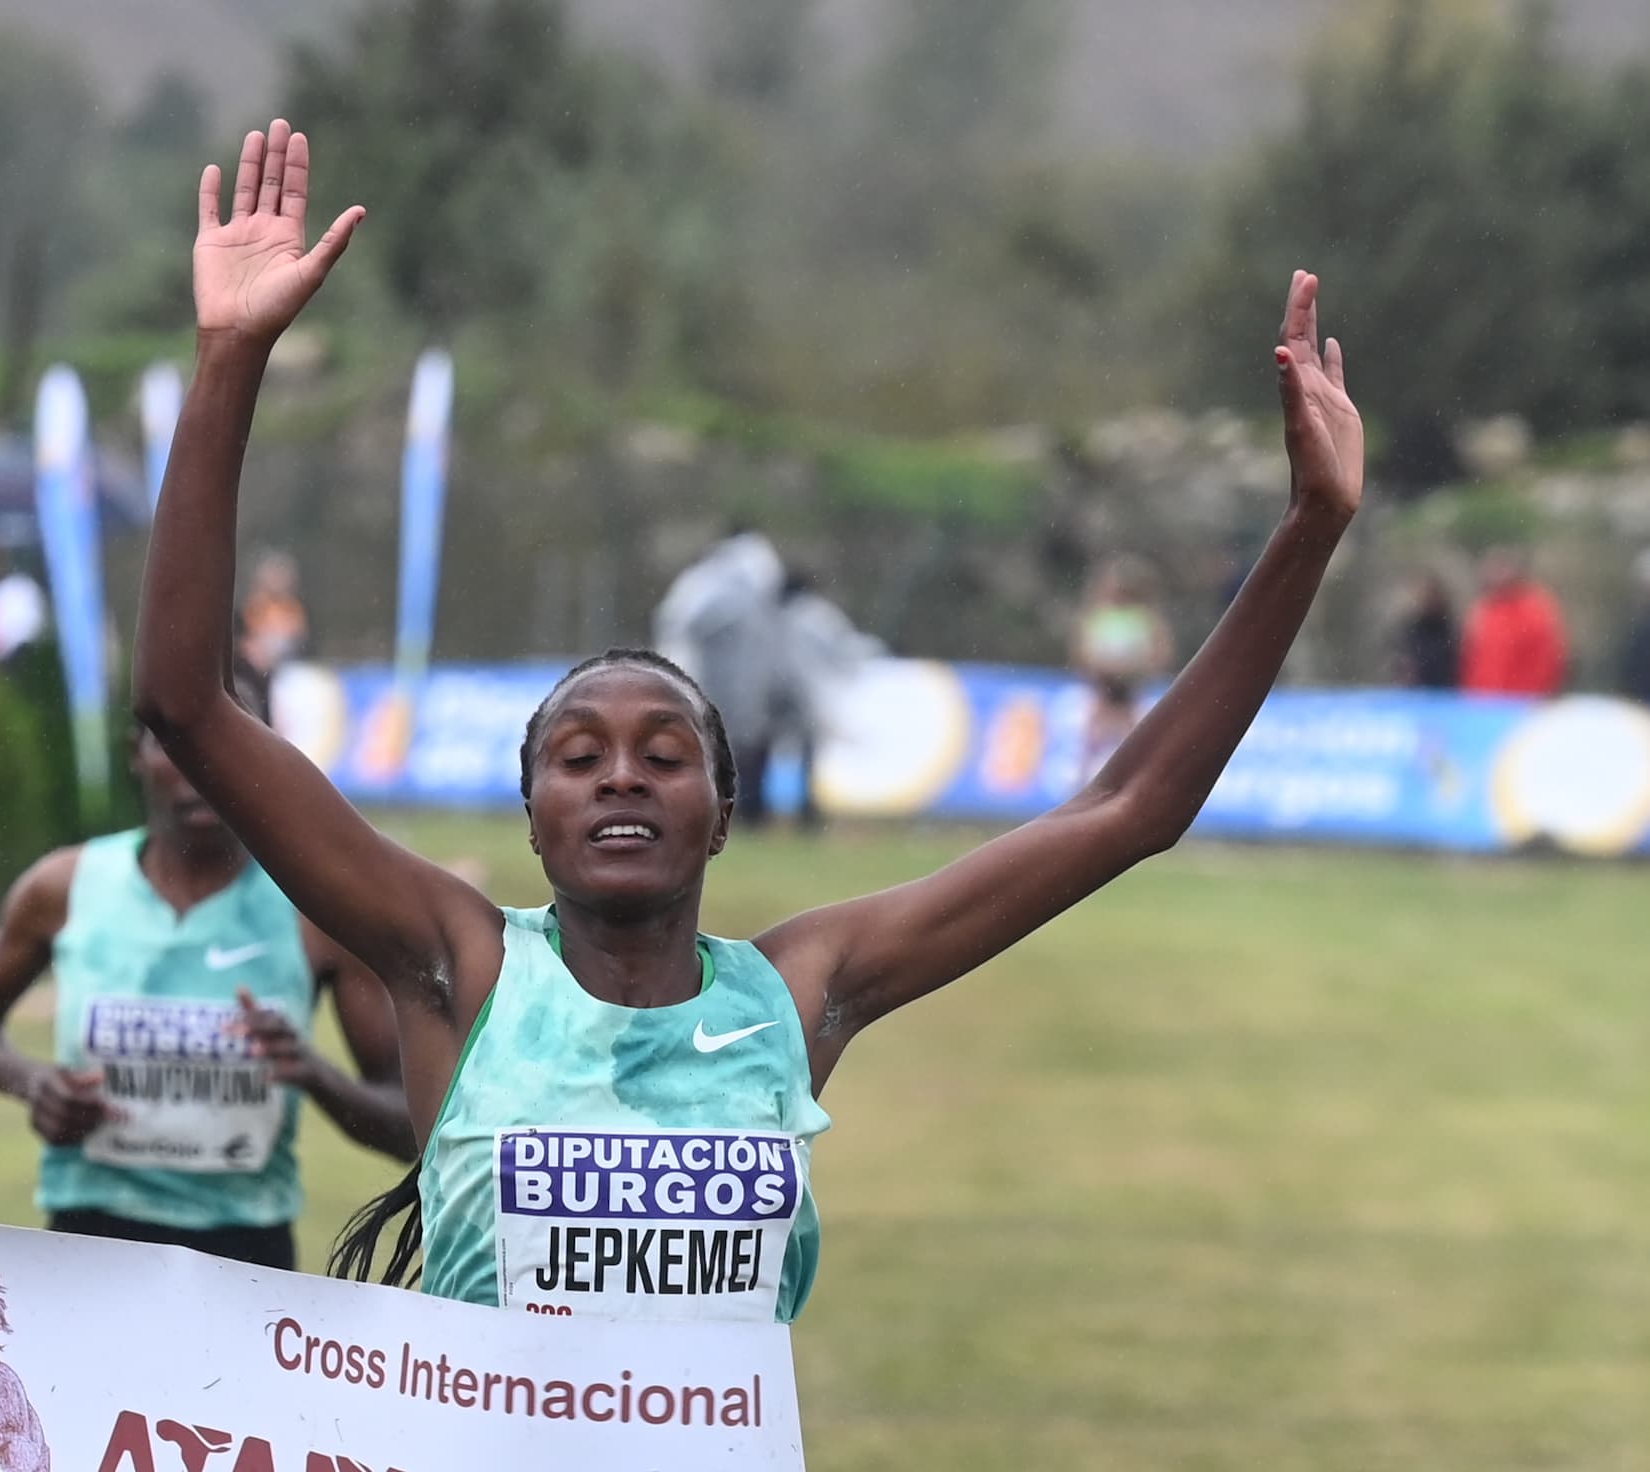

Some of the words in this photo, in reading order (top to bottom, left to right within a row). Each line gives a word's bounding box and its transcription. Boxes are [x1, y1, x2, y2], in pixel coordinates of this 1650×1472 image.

[514, 1136, 785, 1171] DIPUTACIÓN
[514, 1171, 786, 1215] BURGOS
[535, 1226, 764, 1295] JEPKEMEI
[273, 1316, 386, 1389] Cross
[398, 1341, 762, 1427] Internacional
